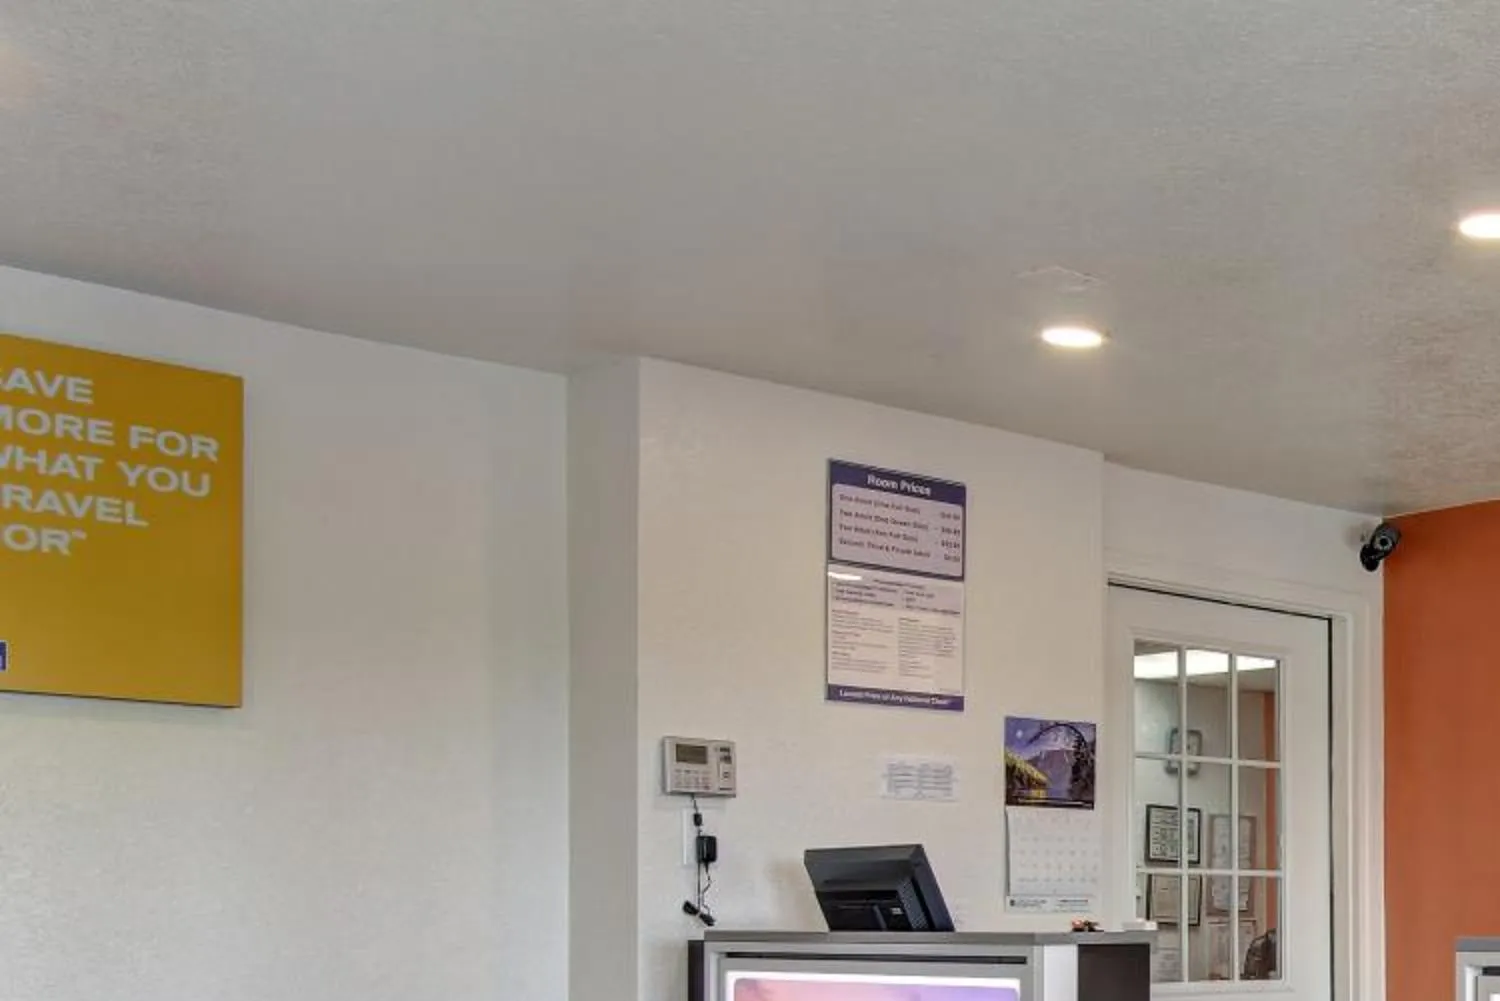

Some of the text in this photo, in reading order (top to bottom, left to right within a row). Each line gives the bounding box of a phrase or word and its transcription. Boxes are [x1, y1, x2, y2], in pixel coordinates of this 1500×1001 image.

[0, 366, 93, 404] AVE
[129, 425, 219, 462] FOR
[117, 460, 211, 498] YOU
[867, 473, 931, 497] Room Prices
